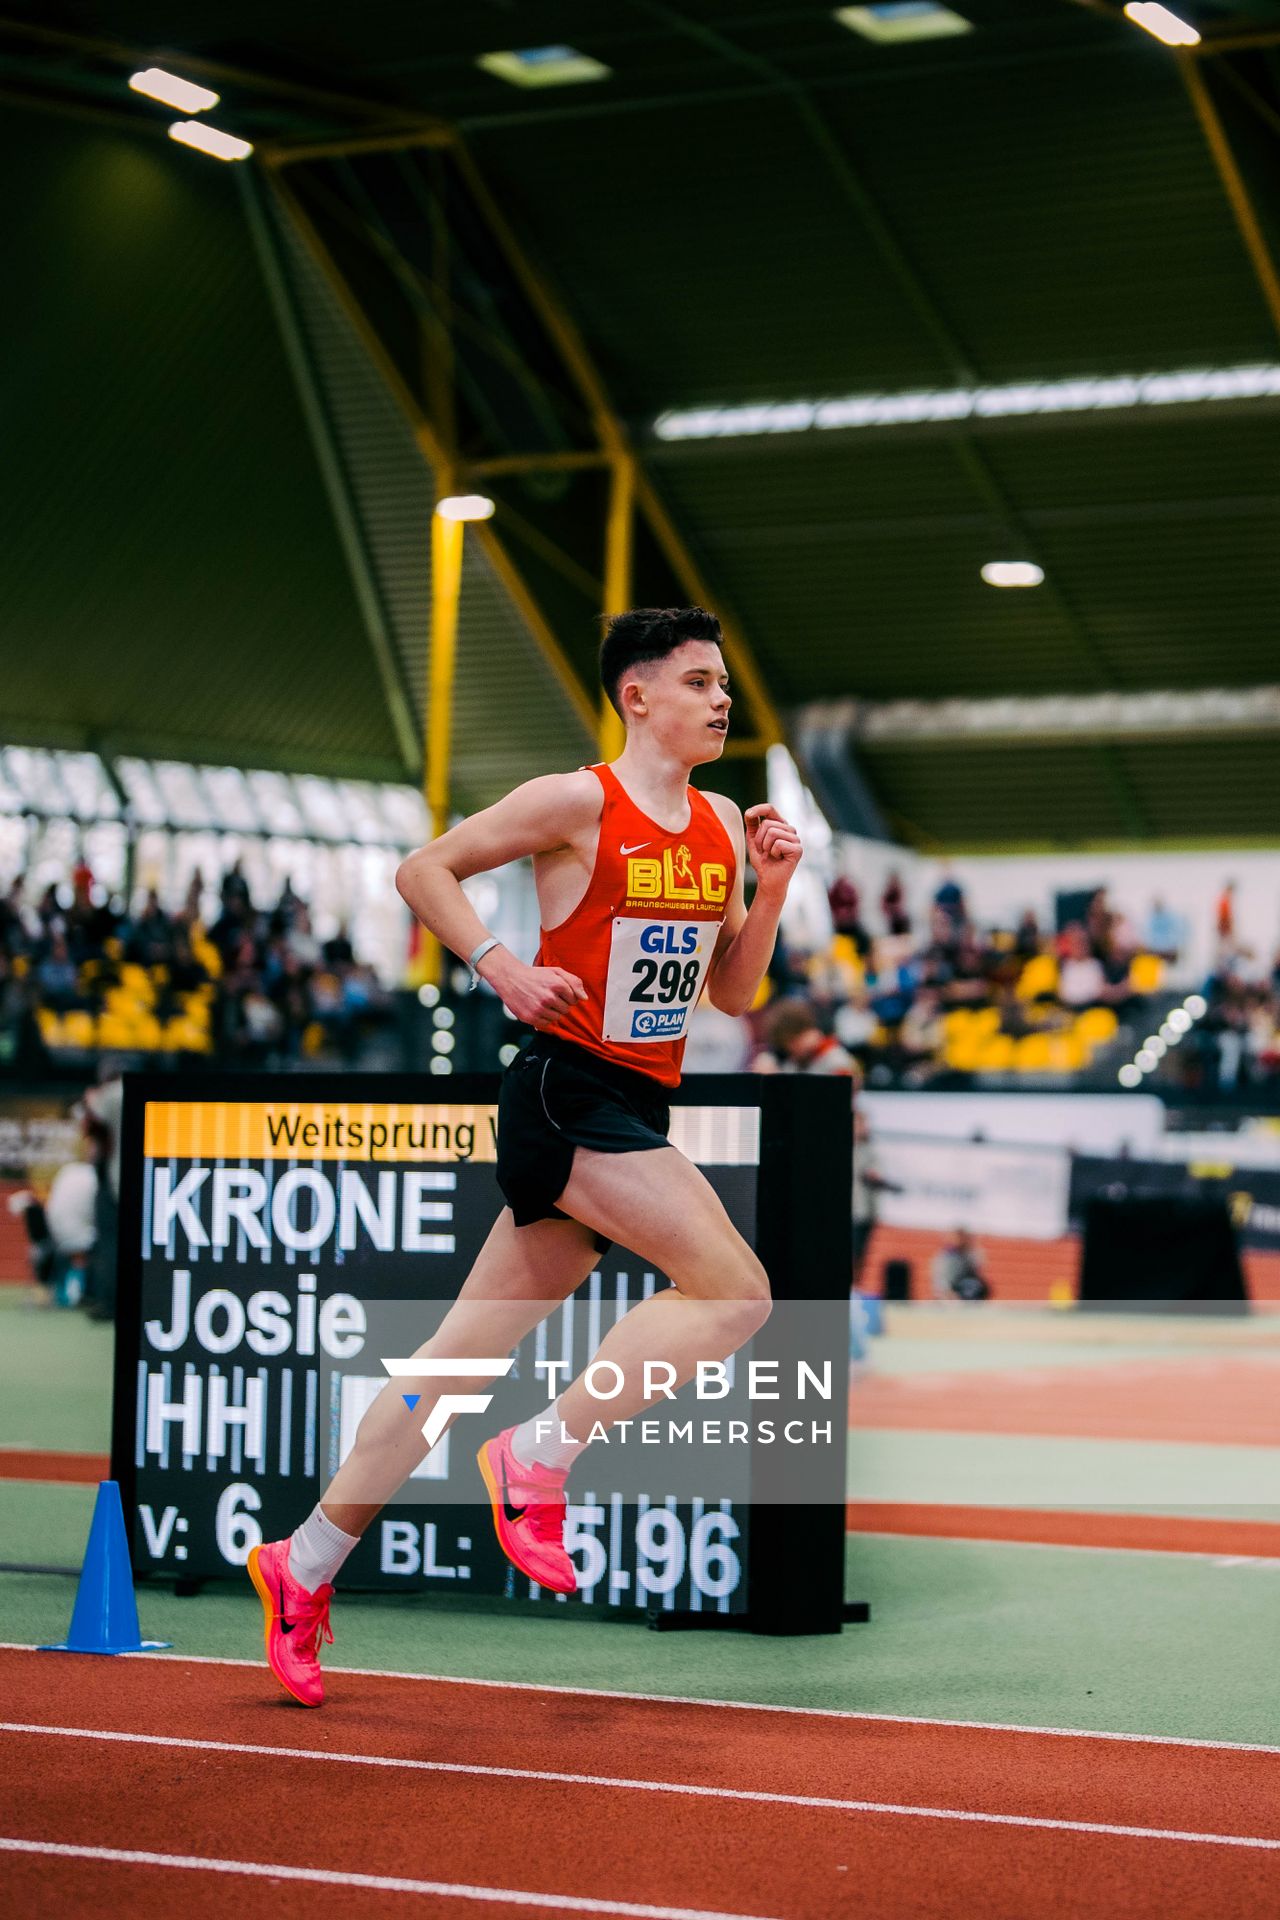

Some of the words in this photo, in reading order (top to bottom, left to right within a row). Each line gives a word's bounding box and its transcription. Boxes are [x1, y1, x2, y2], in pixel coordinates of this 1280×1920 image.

[627, 848, 727, 903] BLC
[628, 958, 700, 1004] 298
[657, 1012, 685, 1027] PLAN
[267, 1115, 475, 1160] Weitsprung
[152, 1167, 456, 1253] KRONE
[144, 1269, 367, 1359] Josie
[146, 1373, 262, 1459] HH
[138, 1504, 189, 1560] V:
[215, 1482, 262, 1567] 6
[380, 1521, 471, 1578] BL:
[563, 1505, 740, 1598] 5.96
